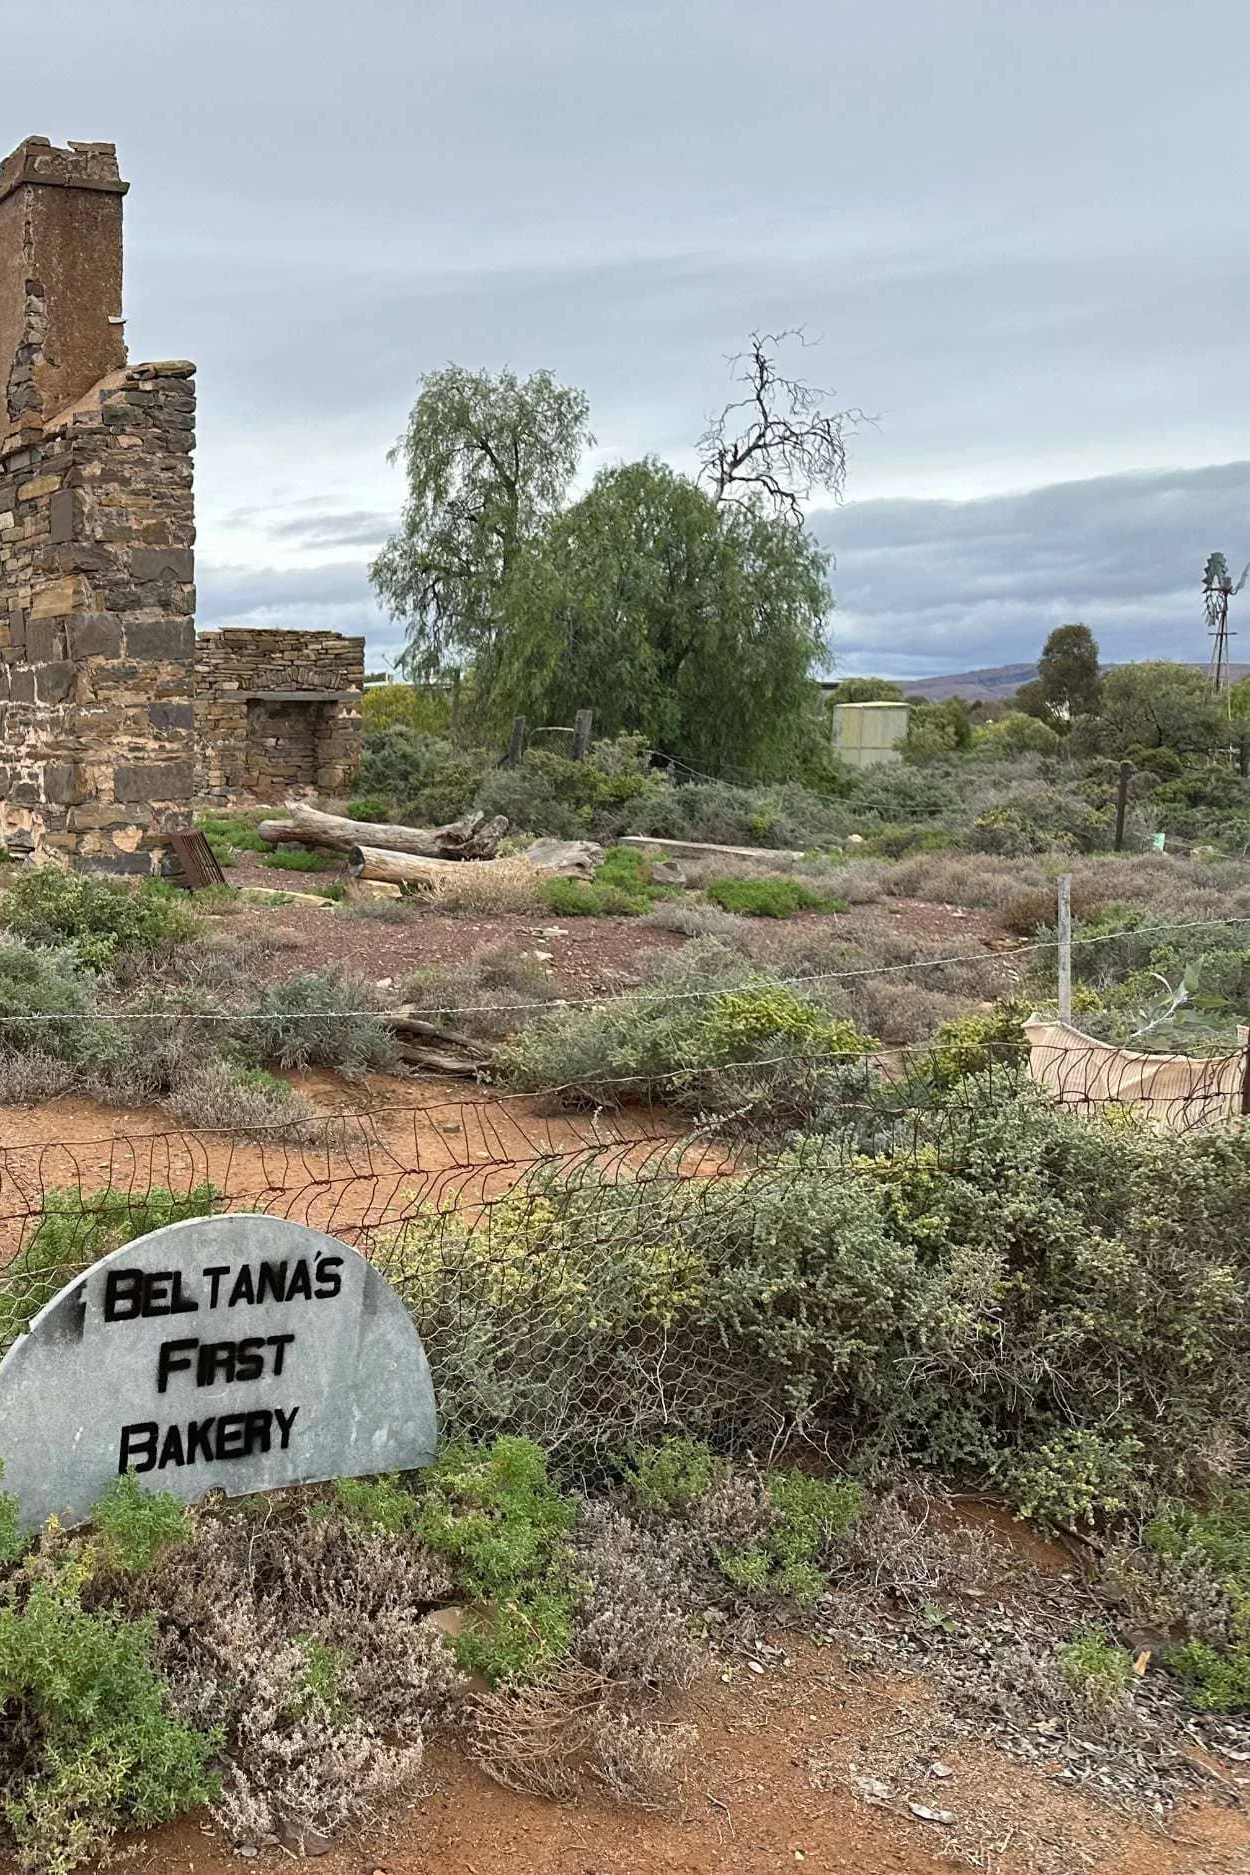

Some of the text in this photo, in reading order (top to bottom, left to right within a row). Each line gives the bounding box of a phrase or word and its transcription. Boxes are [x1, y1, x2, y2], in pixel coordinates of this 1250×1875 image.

[104, 1251, 343, 1322] BELTANA'S
[157, 1333, 295, 1393] FIRST
[118, 1406, 300, 1474] BAKERY
